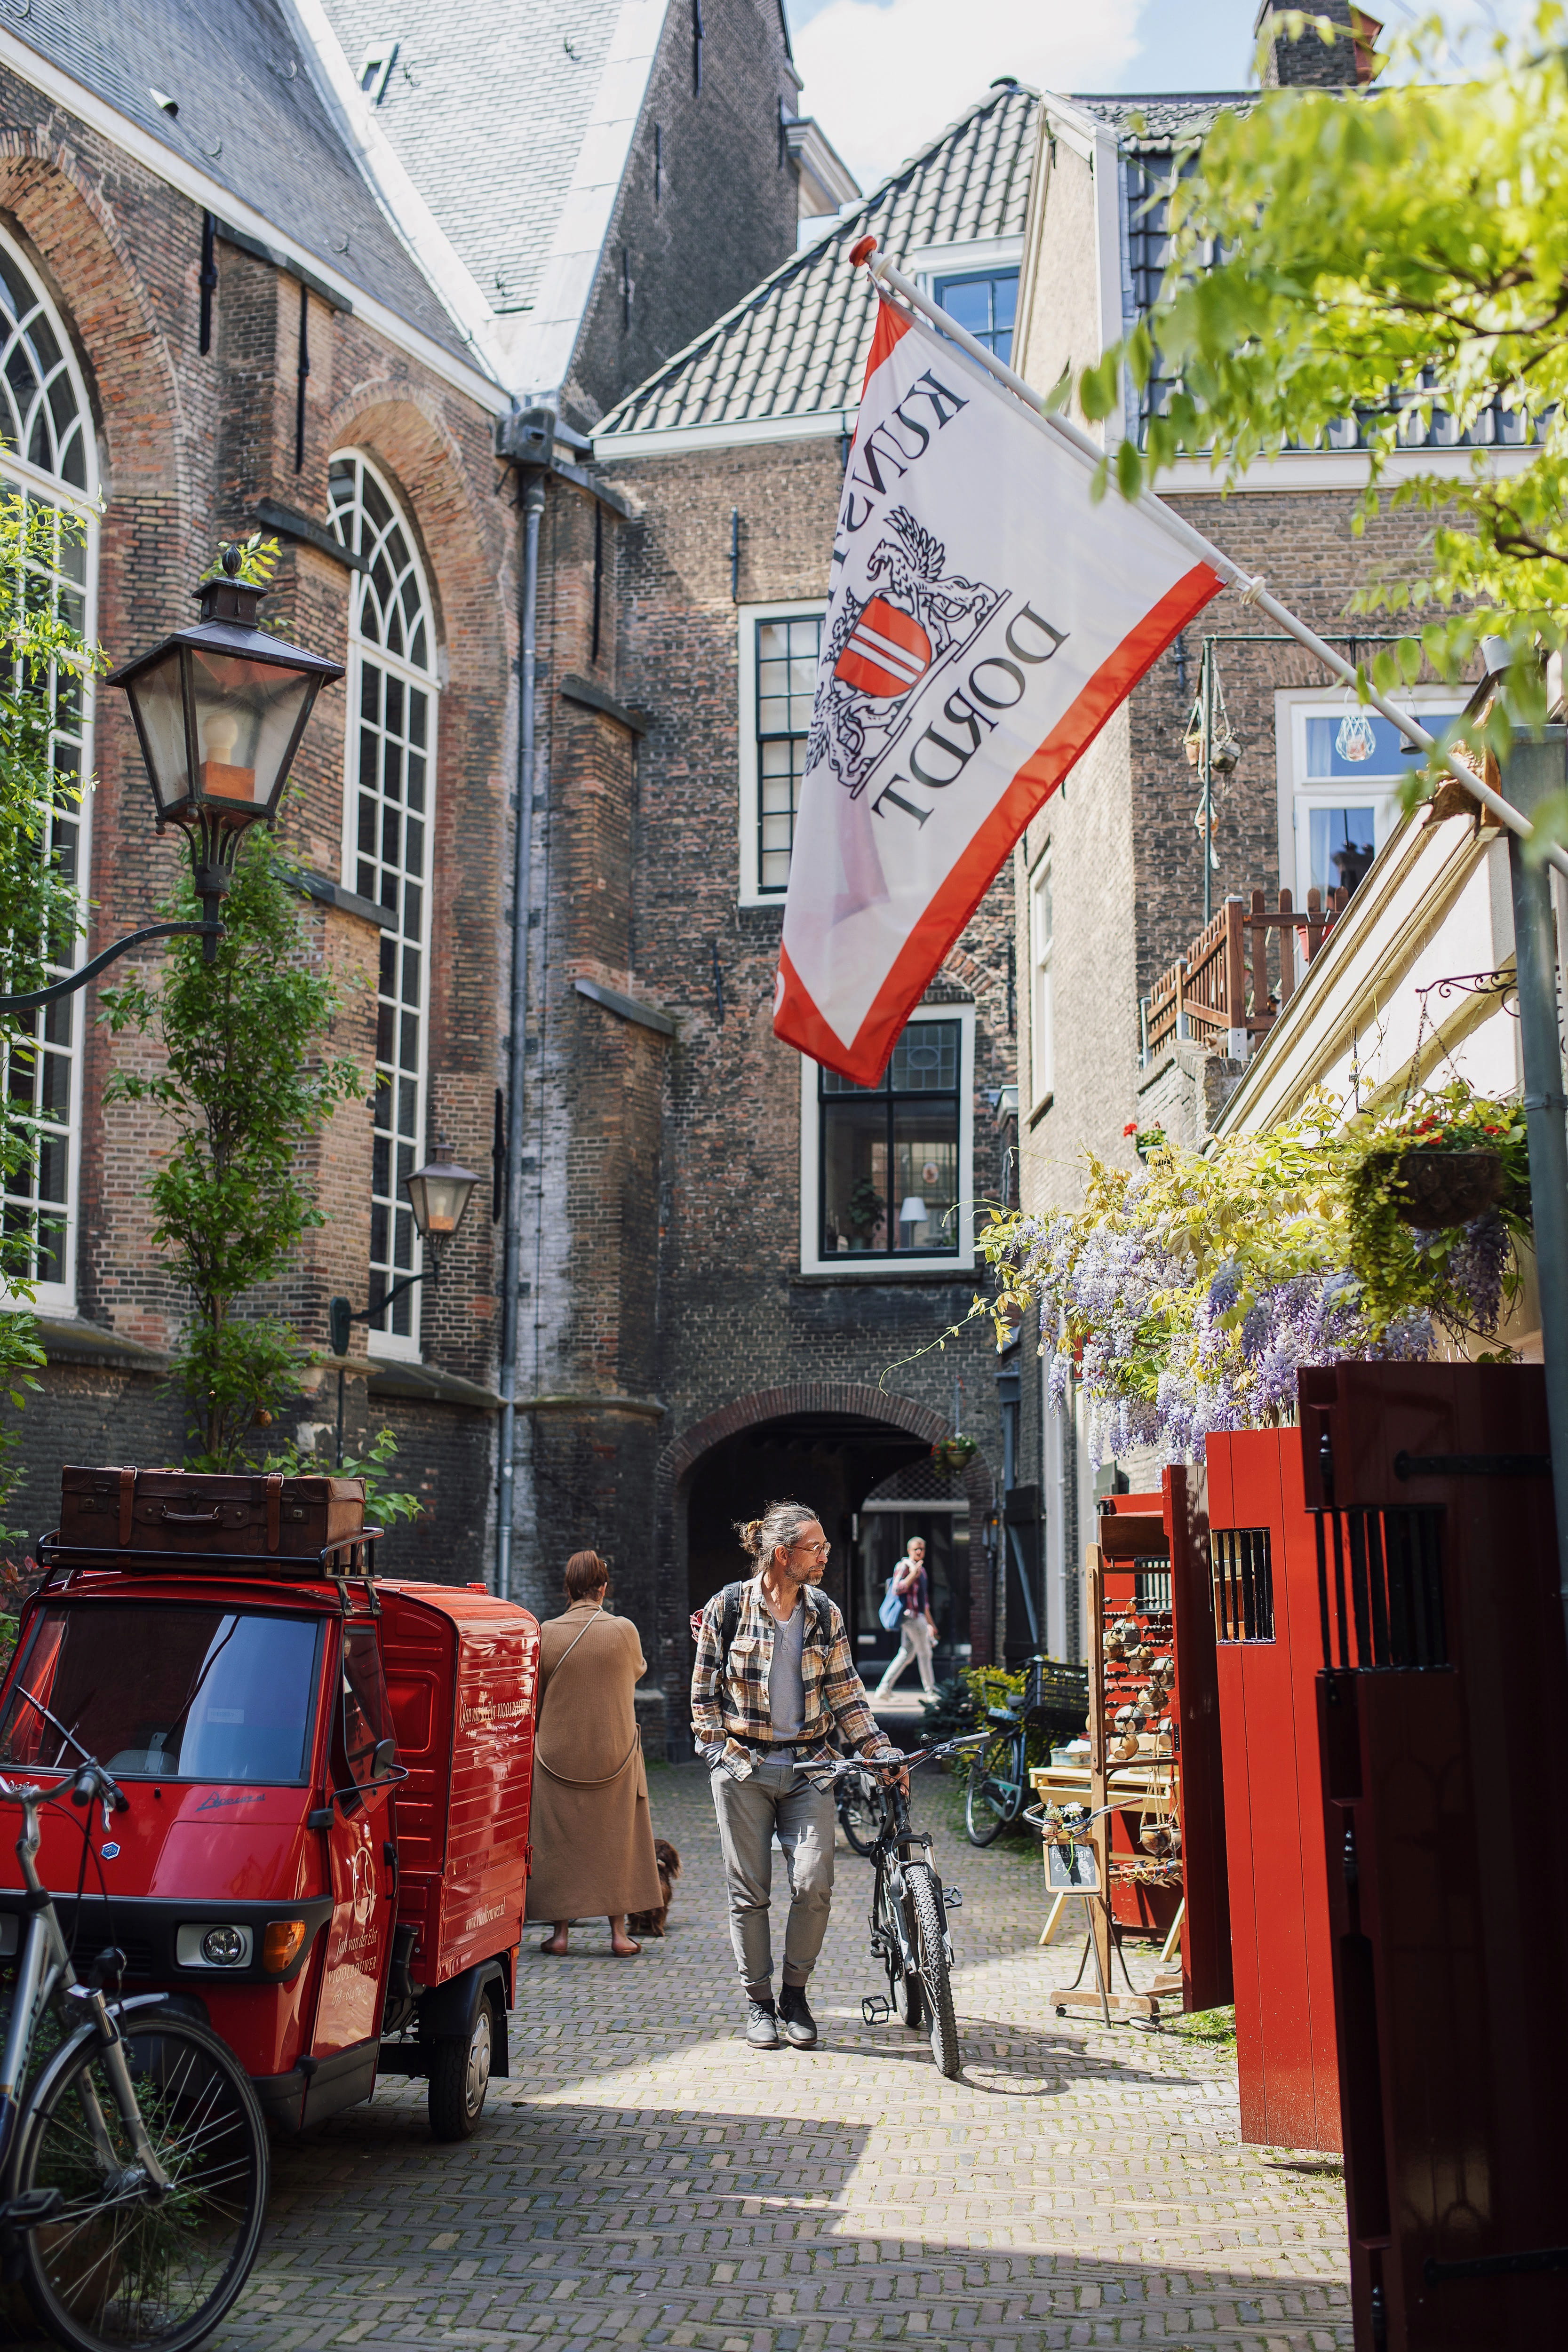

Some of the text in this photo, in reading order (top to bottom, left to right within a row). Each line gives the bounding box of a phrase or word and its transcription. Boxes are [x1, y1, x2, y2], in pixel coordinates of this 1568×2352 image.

[461, 1703, 471, 1732] Jan
[488, 1696, 496, 1721] Elst
[465, 1896, 506, 1932] www.vioolbouwer.nl
[334, 1924, 378, 1963] Jan van der Elst
[328, 1956, 377, 1985] VIOOLBOUWER
